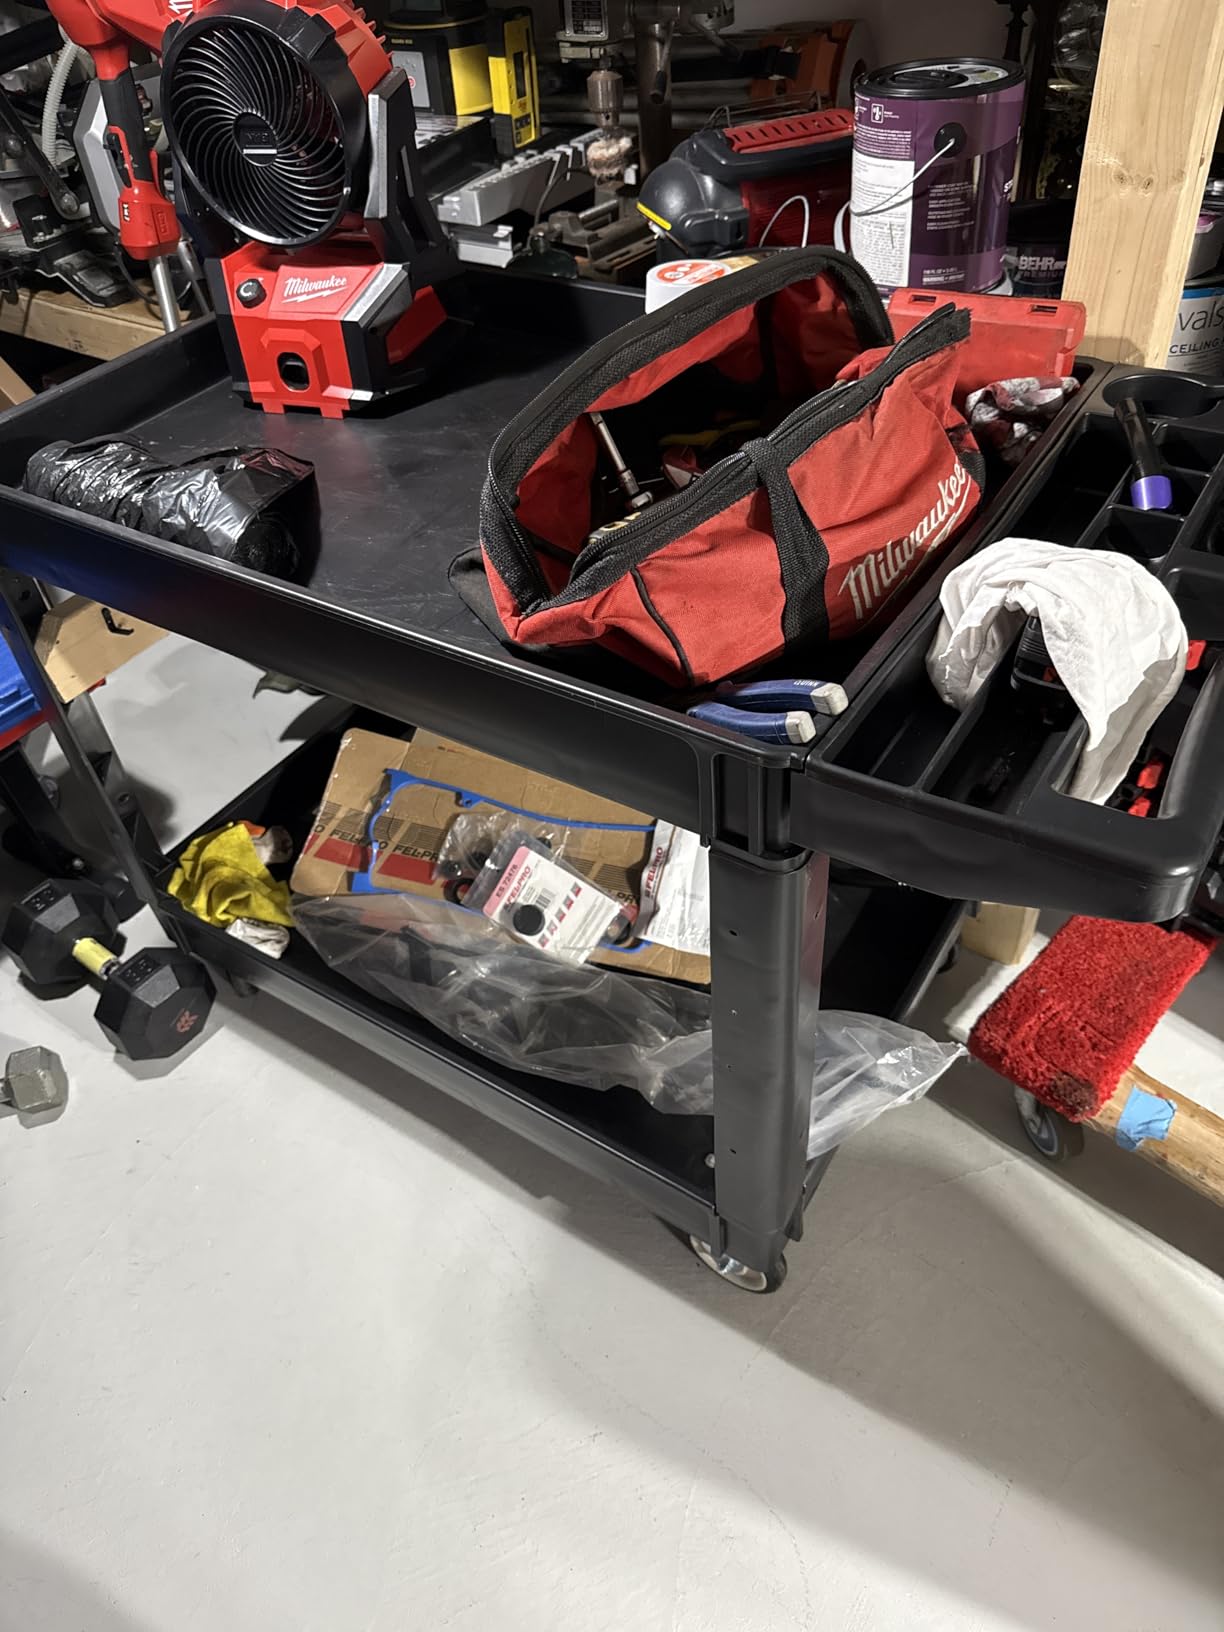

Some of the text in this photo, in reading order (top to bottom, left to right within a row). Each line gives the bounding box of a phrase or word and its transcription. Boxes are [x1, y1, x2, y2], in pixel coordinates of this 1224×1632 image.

[1019, 255, 1055, 270] BEHR
[283, 275, 347, 297] Milwaukee
[1169, 337, 1219, 354] CEILING
[838, 463, 967, 620] Milwaukee
[392, 843, 440, 862] FEL-PR
